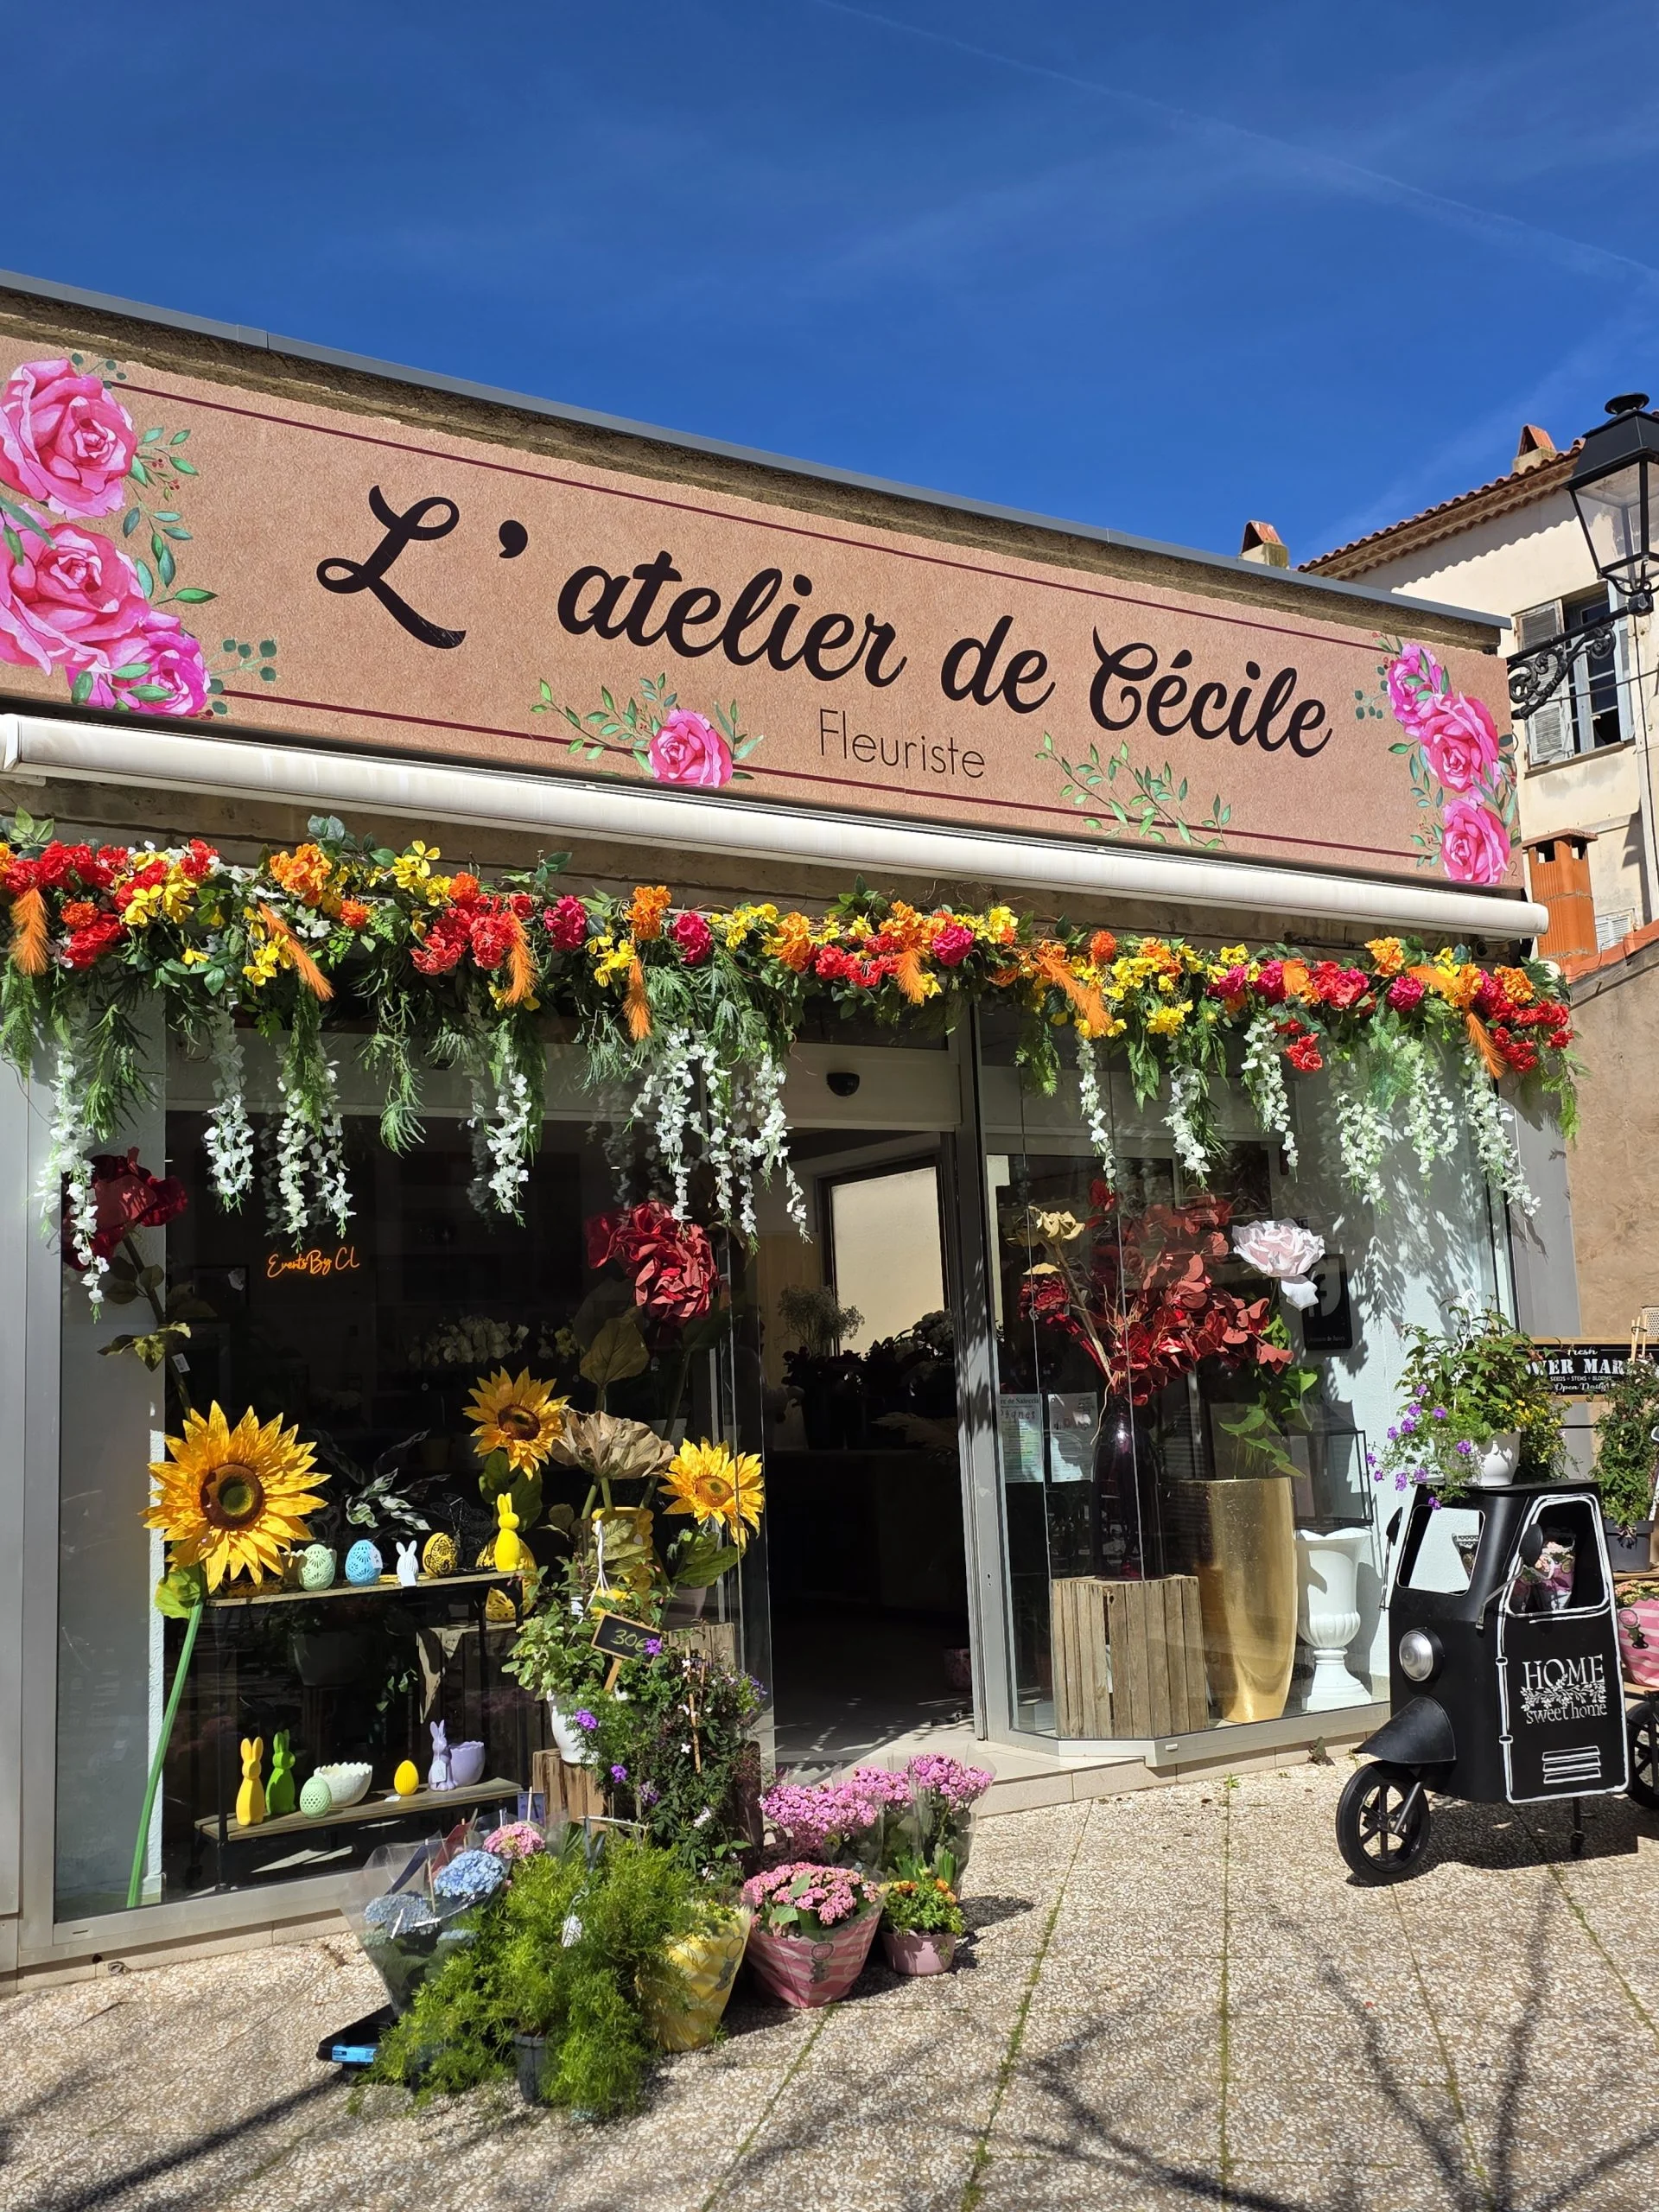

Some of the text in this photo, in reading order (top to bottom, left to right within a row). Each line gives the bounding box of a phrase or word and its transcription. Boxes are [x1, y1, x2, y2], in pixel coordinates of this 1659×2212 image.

[940, 615, 1056, 714] de
[1089, 626, 1332, 759] Cécile
[819, 708, 986, 779] Fleuriste
[1583, 1358, 1625, 1376] MAR
[1554, 1382, 1579, 1392] Open
[611, 1629, 650, 1653] 30€
[1522, 1653, 1605, 1691] HOME
[1526, 1701, 1608, 1725] sweet home
